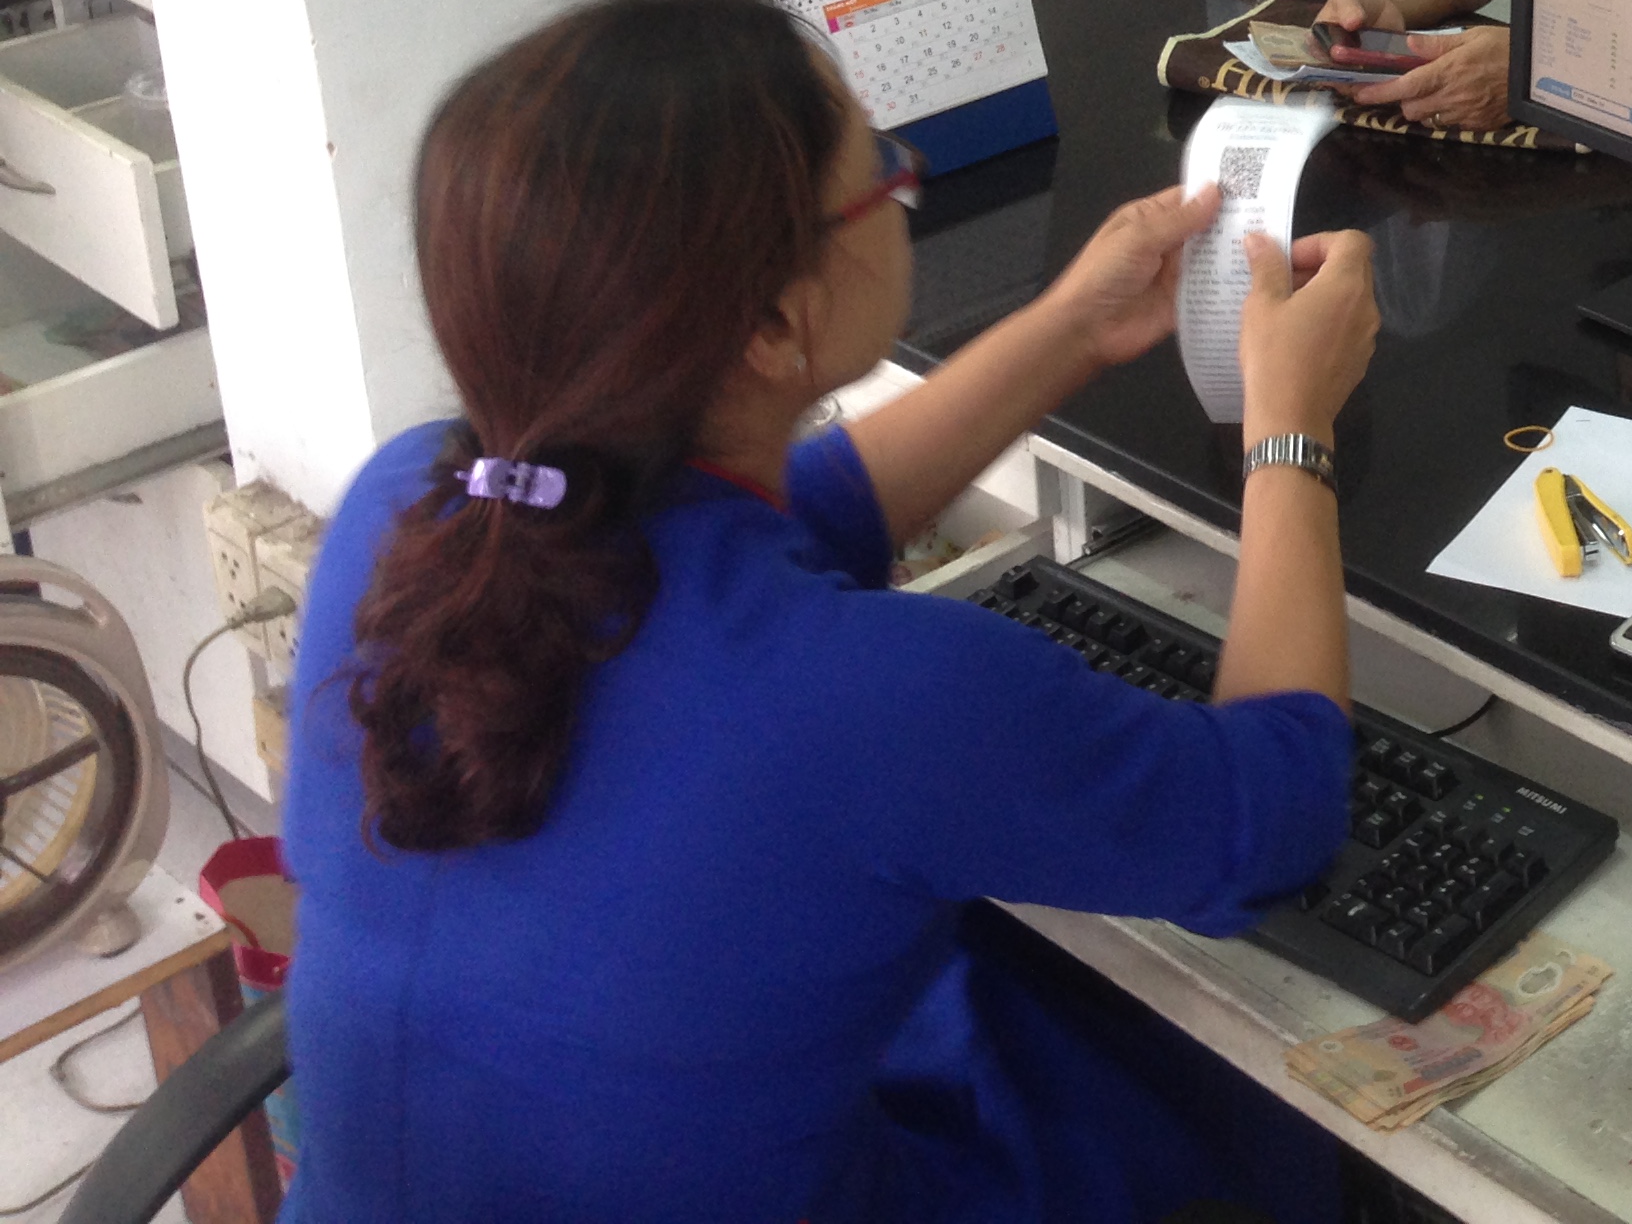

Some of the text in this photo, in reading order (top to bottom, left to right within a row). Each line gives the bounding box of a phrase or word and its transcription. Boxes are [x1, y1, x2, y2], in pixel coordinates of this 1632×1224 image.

[853, 51, 859, 59] 8
[876, 44, 882, 52] 9
[895, 36, 905, 45] 10
[919, 29, 928, 38] 11
[942, 22, 952, 30] 12
[965, 14, 974, 23] 13
[870, 25, 876, 33] 2
[894, 17, 900, 25] 3
[917, 10, 923, 18] 4
[941, 2, 947, 10] 5
[877, 63, 886, 72] 16
[924, 48, 933, 56] 18
[947, 40, 956, 49] 19
[969, 32, 979, 42] 20
[992, 25, 1001, 34] 21
[882, 82, 892, 91] 23
[904, 75, 914, 84] 24
[927, 67, 938, 76] 25
[951, 59, 962, 68] 26
[973, 51, 983, 61] 27
[996, 44, 1006, 52] 28
[886, 101, 896, 110] 30
[909, 94, 919, 103] 31
[1515, 786, 1568, 815] MITSUMI
